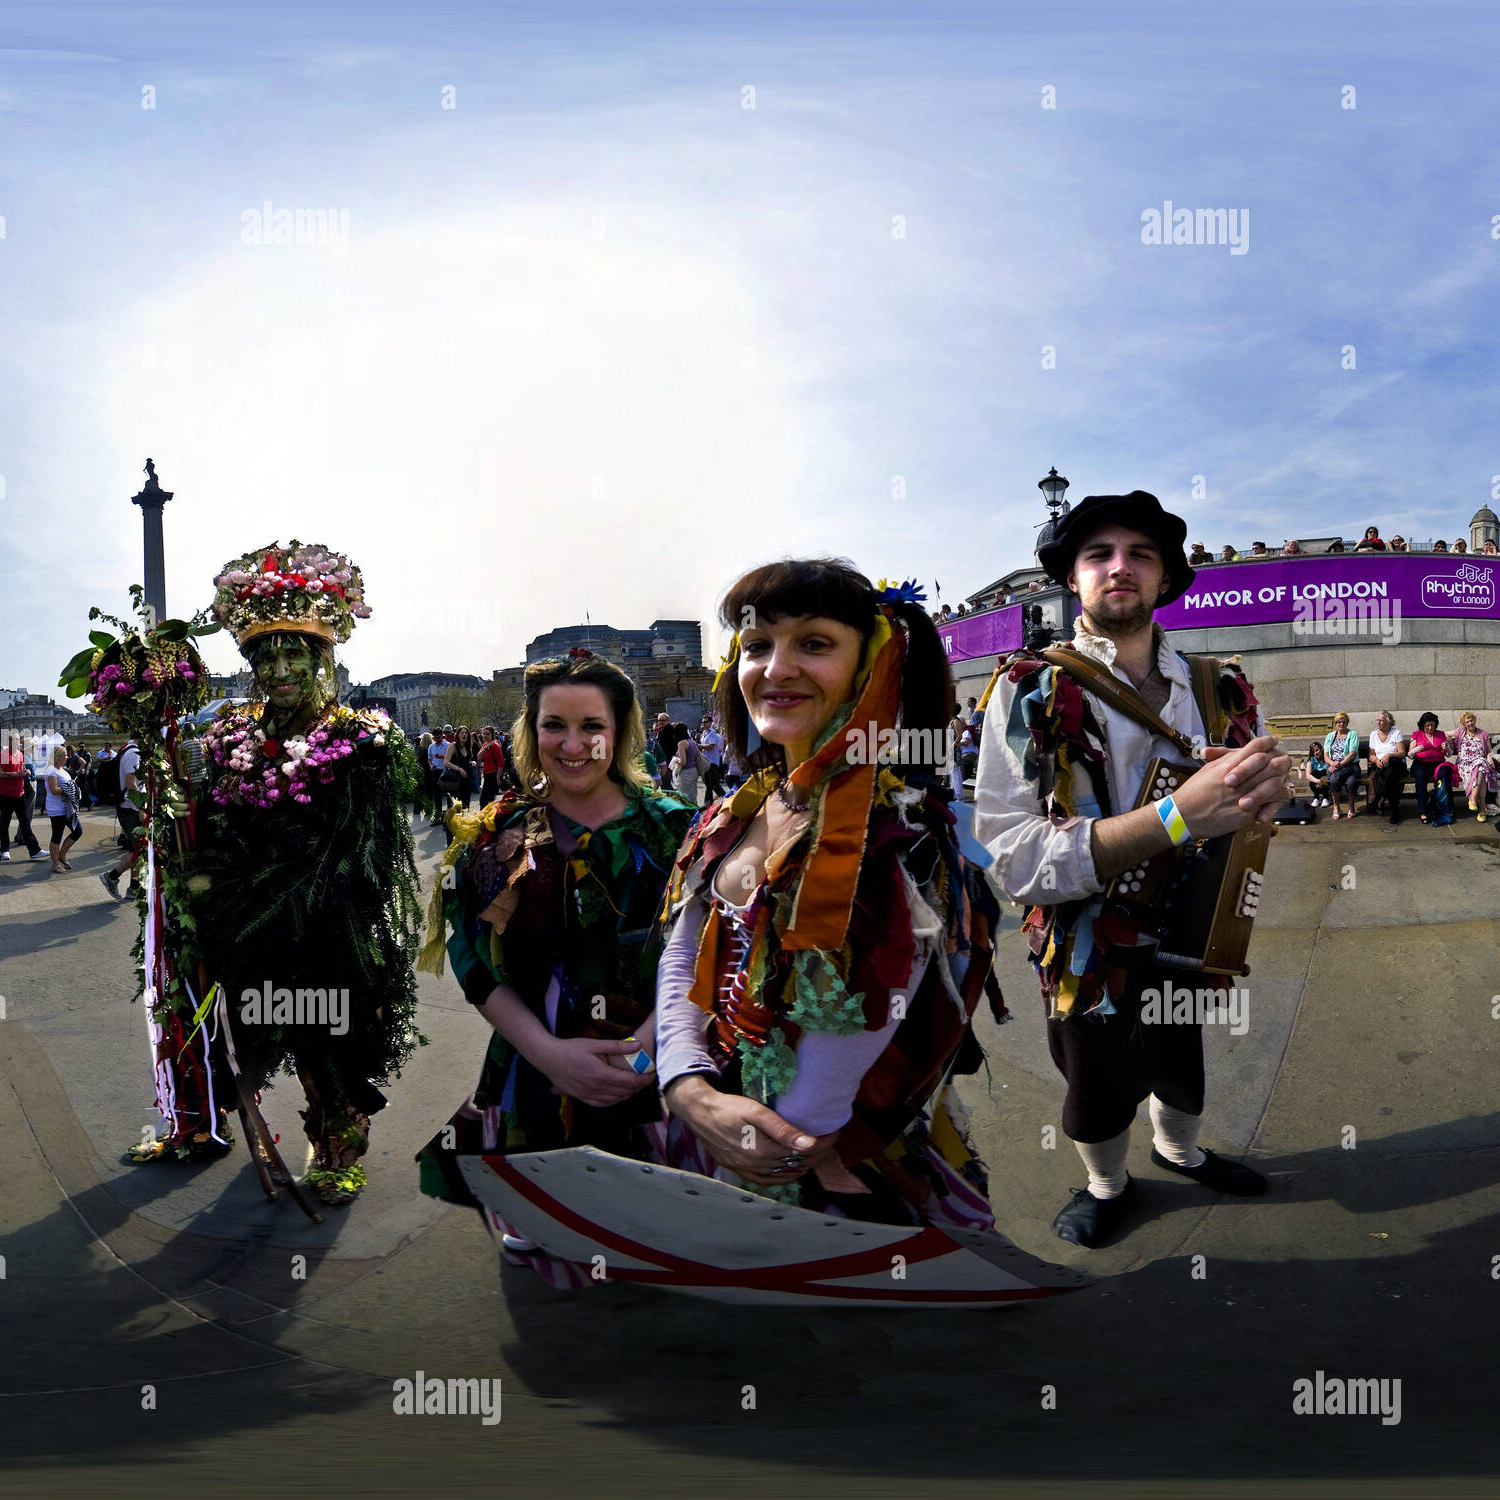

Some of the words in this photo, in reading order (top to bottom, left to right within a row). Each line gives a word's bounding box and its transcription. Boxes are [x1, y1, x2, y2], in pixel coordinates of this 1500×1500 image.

[1184, 590, 1253, 610] MAYOR
[1258, 586, 1287, 603] OF
[1292, 581, 1387, 601] LONDON
[1426, 580, 1490, 597] Rhythm
[1453, 596, 1462, 604] OF
